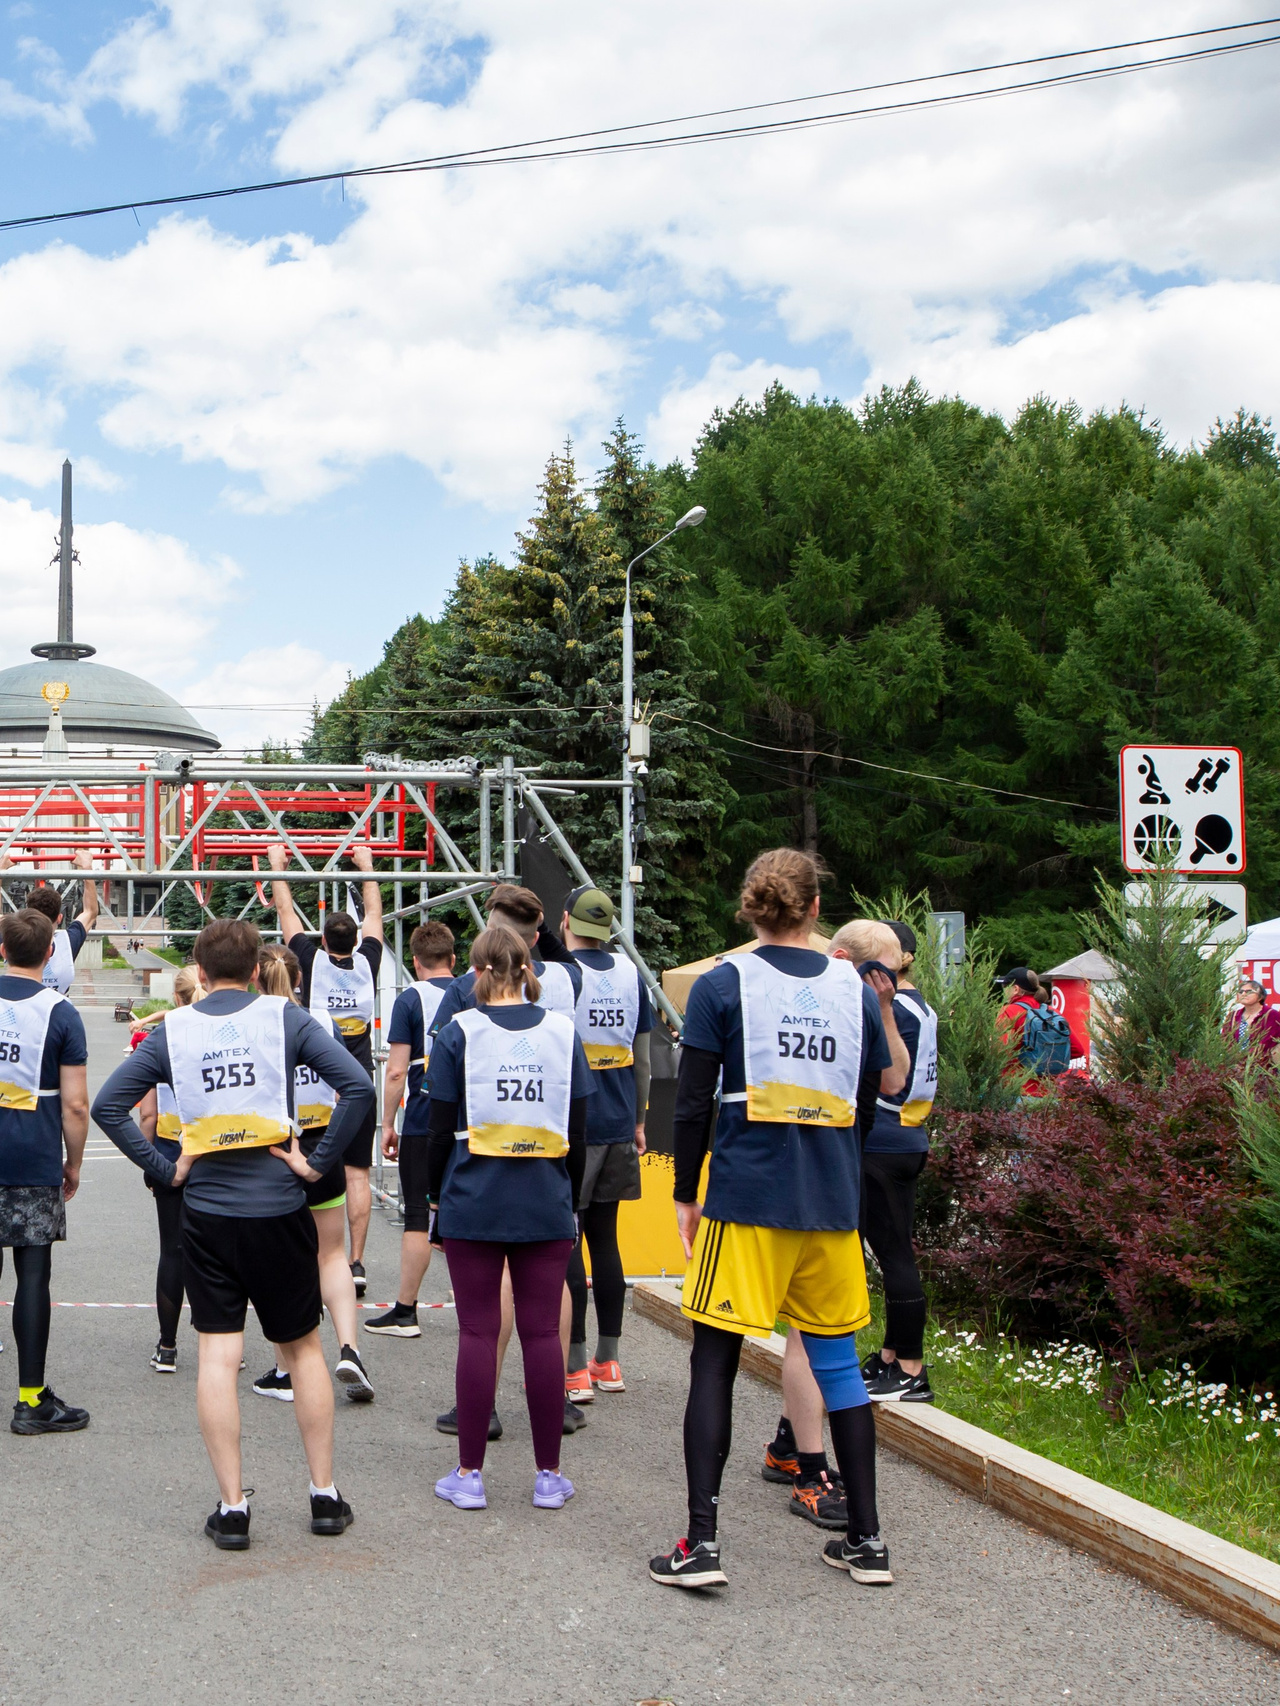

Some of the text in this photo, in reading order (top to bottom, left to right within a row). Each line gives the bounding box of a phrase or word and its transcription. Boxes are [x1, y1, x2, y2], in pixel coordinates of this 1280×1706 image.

[327, 996, 358, 1008] 5251
[589, 1009, 624, 1027] 5255
[781, 1015, 831, 1028] AMTEX
[202, 1046, 251, 1061] AMTEX
[778, 1031, 836, 1063] 5260
[498, 1064, 544, 1073] AMTEX
[201, 1062, 256, 1093] 5253
[496, 1079, 544, 1102] 5261
[219, 1129, 245, 1145] URBAN
